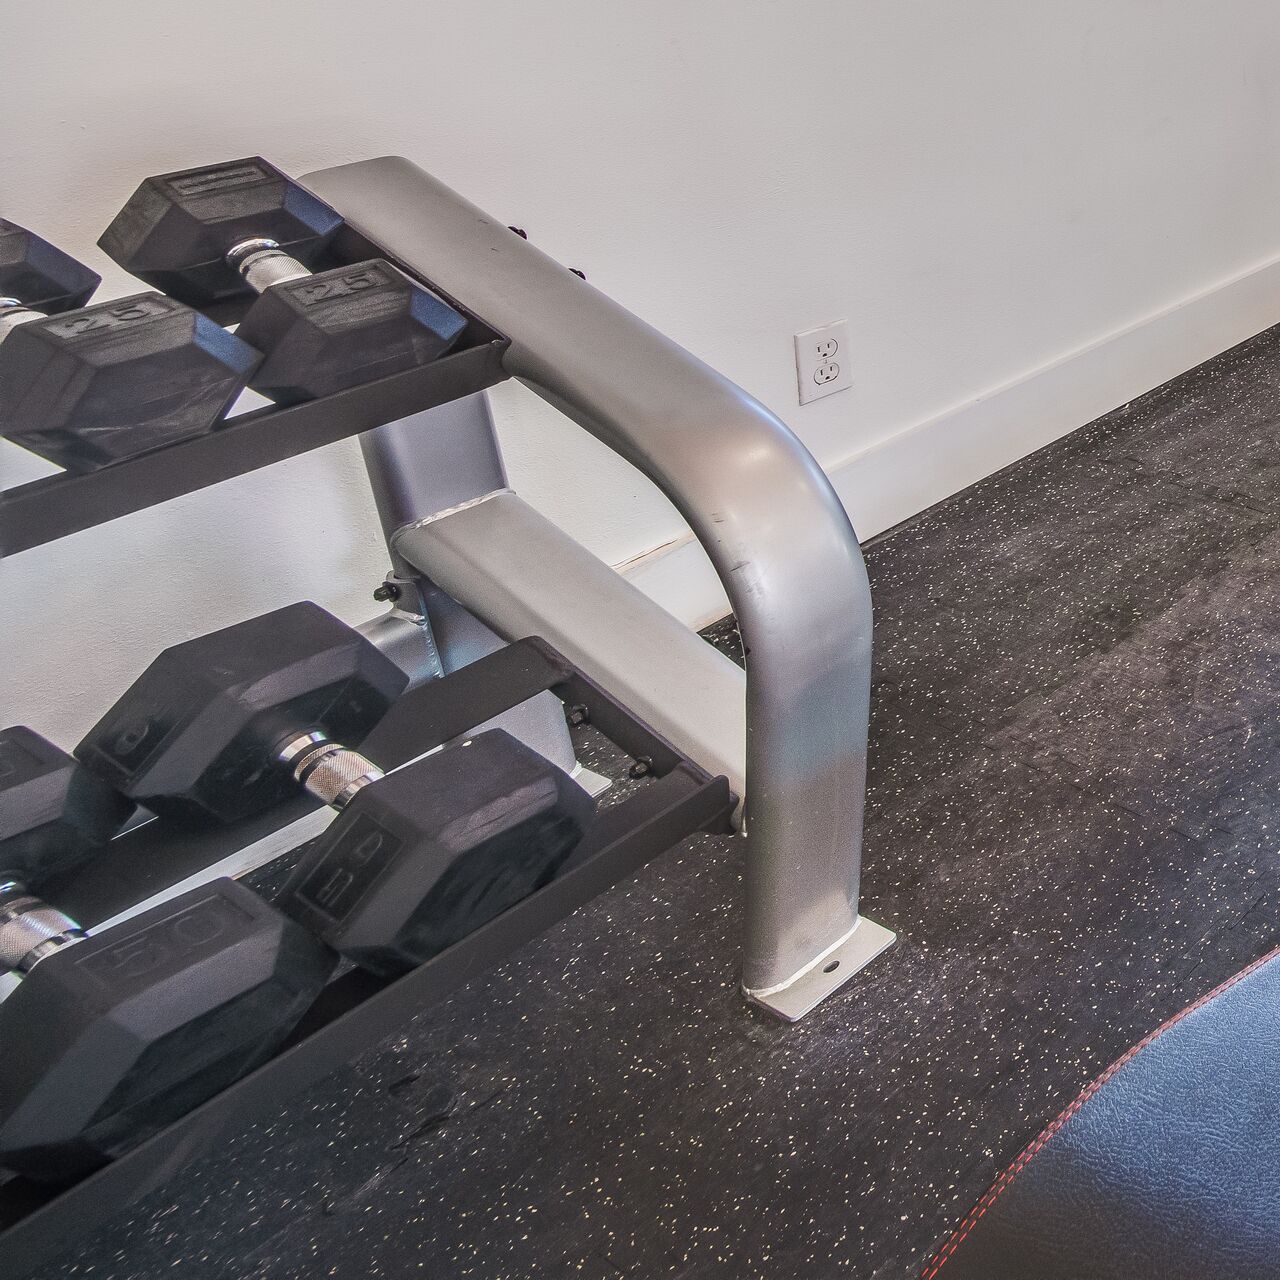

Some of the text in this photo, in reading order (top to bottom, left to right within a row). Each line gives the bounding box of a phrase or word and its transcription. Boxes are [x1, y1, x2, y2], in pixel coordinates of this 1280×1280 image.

[306, 272, 377, 302] 25
[65, 307, 149, 335] 25
[111, 911, 228, 979] 50
